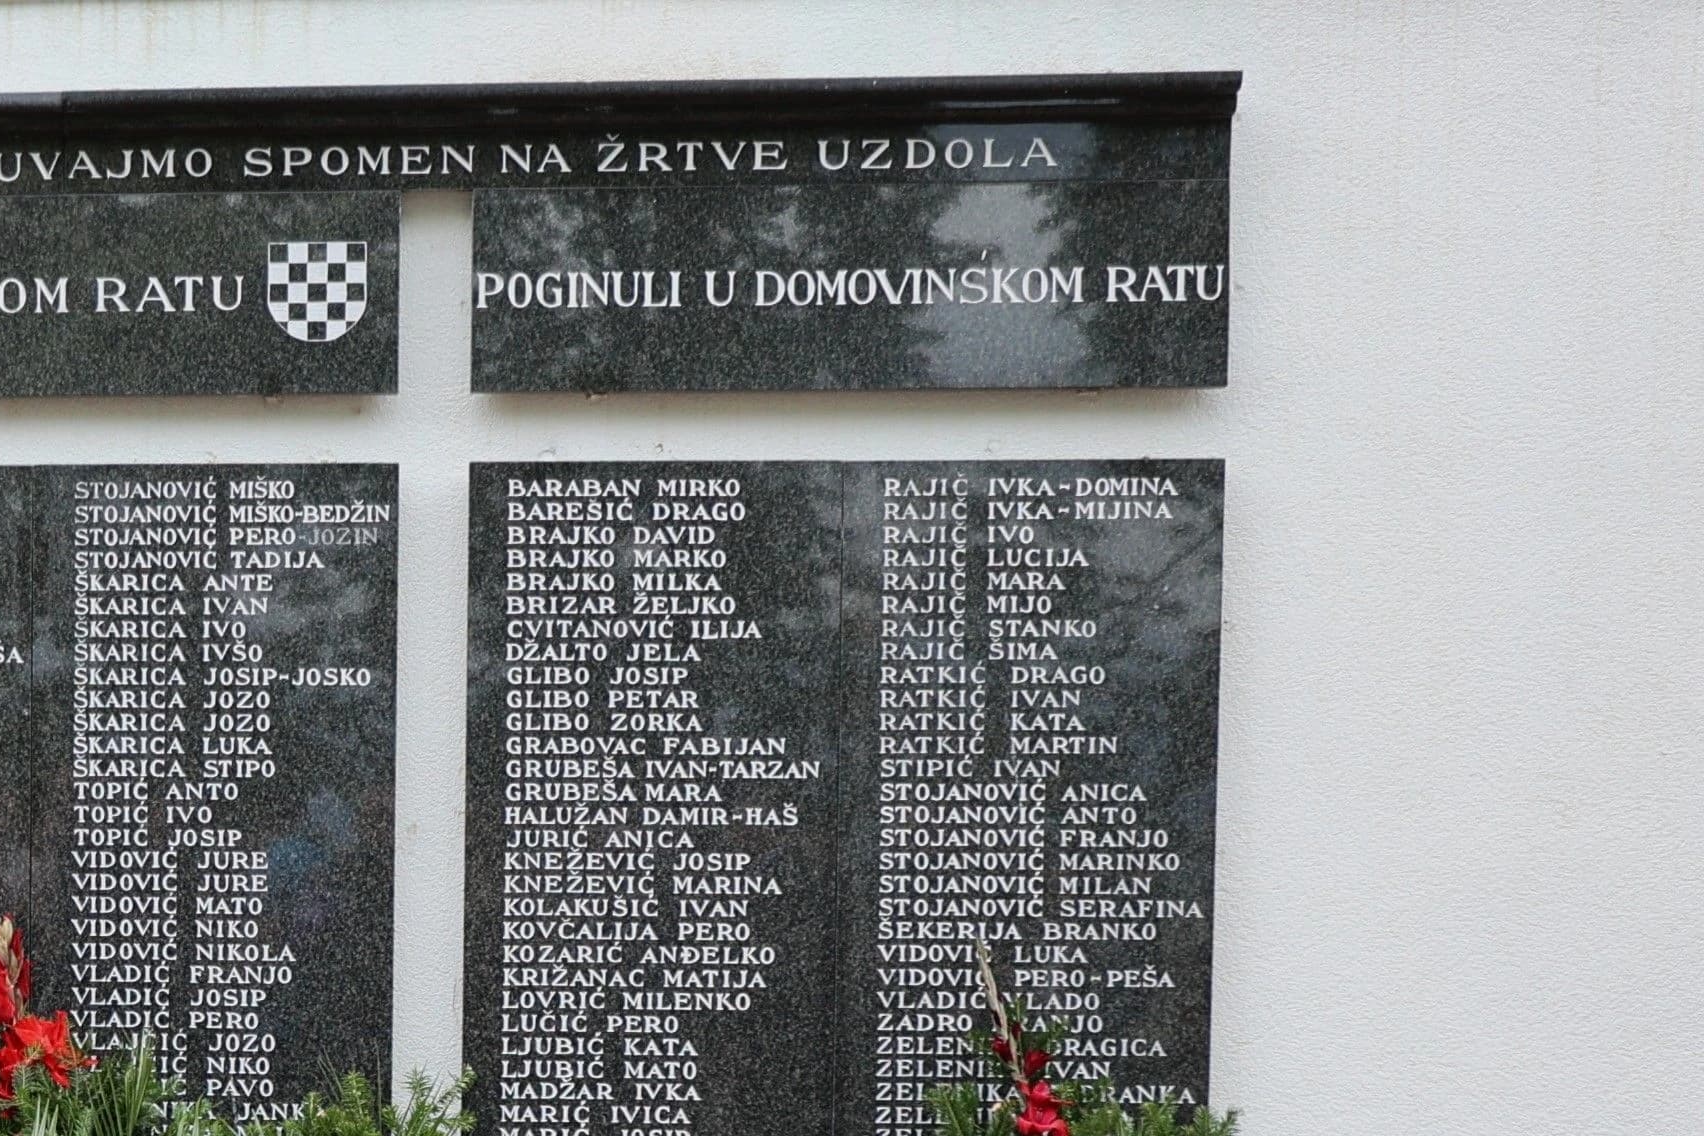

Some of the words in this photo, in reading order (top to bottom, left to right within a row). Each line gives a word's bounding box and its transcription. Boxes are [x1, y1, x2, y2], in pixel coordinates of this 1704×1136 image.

[245, 147, 475, 178] SPOMEN
[502, 145, 572, 174] NA
[598, 134, 788, 173] ŽRTVE
[819, 139, 1058, 171] UZDOLA
[96, 276, 245, 314] RATU
[477, 272, 683, 310] POGINULI
[706, 271, 737, 308] U
[1107, 266, 1226, 304] RATU
[508, 478, 641, 497] BARABAN
[657, 478, 741, 497] MIRKO
[73, 498, 217, 524] STOJANOVIĆ
[228, 498, 391, 524] MIŠKO-BEDŽIN
[73, 544, 217, 569] STOJANOVIĆ
[230, 550, 325, 569] TADIJA
[881, 542, 967, 567] RAJIČ
[986, 548, 1090, 567] LUCIJA
[505, 596, 618, 615] BRIZAR
[632, 590, 736, 615] ŽELJKO
[507, 613, 674, 639] CVITANOVIĆ
[690, 620, 760, 640] ILIJA
[881, 613, 966, 638] RAJIČ
[988, 619, 1097, 638] STANKO
[73, 637, 186, 662] ŠKARICA
[202, 637, 263, 662] IVŠO
[505, 636, 608, 662] DŽALTO
[626, 643, 702, 662] JELA
[879, 660, 986, 684] RATKIĆ
[1011, 666, 1106, 684] DRAGO
[72, 730, 185, 755] ŠKARICA
[202, 736, 272, 755] LUKA
[505, 736, 646, 755] GRABOVAC
[663, 737, 786, 756] FABIJAN
[879, 730, 985, 754] RATKIĆ
[1010, 736, 1118, 755] MARTIN
[880, 753, 973, 777] STIPIĆ
[994, 759, 1061, 778] IVAN
[73, 775, 149, 800] TOPIĆ
[167, 782, 239, 801] ANTO
[879, 822, 1045, 847] STOJANOVIĆ
[1060, 829, 1169, 848] FRANJO
[70, 844, 178, 869] VIDOVIĆ
[197, 851, 269, 870] JURE
[503, 868, 655, 894] KNEŽEVIĆ
[673, 876, 782, 895] MARINA
[878, 892, 1044, 917] STOJANOVIĆ
[1059, 899, 1202, 918] SERAFINA
[877, 915, 1023, 940] ŠEKERIJA
[1042, 922, 1157, 941] BRANKO
[72, 936, 178, 960] VIDOVIĆ
[195, 943, 294, 962] NIKOLA
[502, 938, 623, 964] KOZARIĆ
[640, 946, 776, 965] ANĐELKO
[72, 958, 170, 983] VLADIĆ
[190, 965, 293, 984] FRANJO
[502, 984, 606, 1009] LOVRIĆ
[621, 992, 751, 1011] MILENKO
